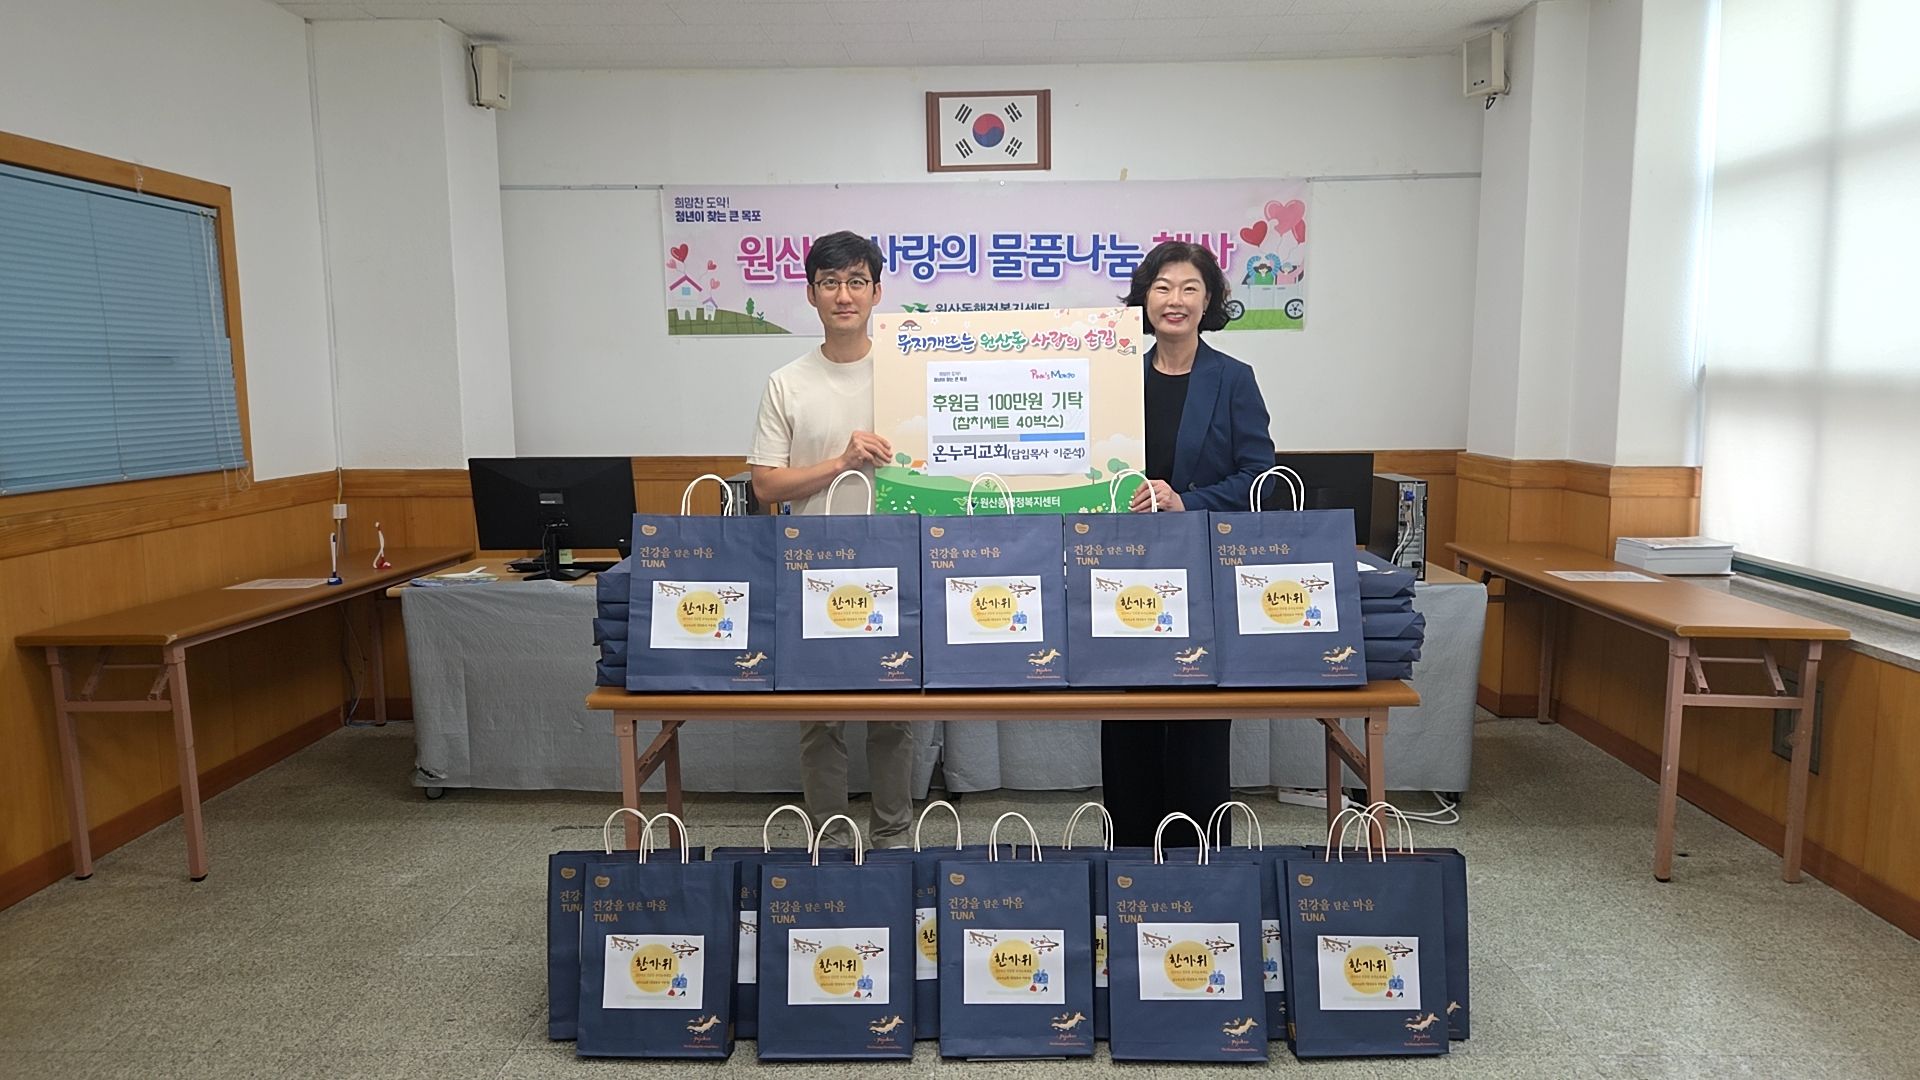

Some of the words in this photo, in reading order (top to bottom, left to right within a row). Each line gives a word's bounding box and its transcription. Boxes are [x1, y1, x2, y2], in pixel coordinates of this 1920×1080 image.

[674, 196, 703, 209] 희망찬
[675, 210, 704, 222] 청년이
[707, 210, 727, 222] 찾는
[729, 210, 740, 222] 큰
[741, 210, 762, 222] 목포
[736, 236, 812, 281] 원산
[987, 233, 1145, 279] 물품나눔
[1152, 231, 1234, 270] 사
[980, 330, 1027, 351] 원산동
[1031, 331, 1079, 350] 사랑의
[1084, 328, 1116, 347] 손길
[932, 394, 980, 413] 후원금
[987, 391, 1043, 411] 100만원
[1051, 391, 1084, 410] 기탁
[952, 415, 1010, 431] (참치세트
[1016, 414, 1064, 429] 40박스)
[1053, 447, 1085, 460] 이준석)
[639, 546, 671, 559] 건강을
[693, 546, 715, 559] 마음
[783, 549, 815, 561] 건강을
[835, 548, 857, 560] 마음
[929, 546, 960, 560] 건강을
[980, 546, 1001, 559] 마음
[1073, 544, 1104, 557] 건강을
[1125, 543, 1147, 556] 마음
[1216, 543, 1248, 556] 건강을
[1268, 543, 1291, 555] 마음
[640, 560, 666, 569] TUNA
[785, 562, 809, 571] TUNA
[930, 560, 955, 569] TUNA
[1076, 557, 1100, 566] TUNA
[1219, 557, 1243, 566] TUNA
[831, 596, 868, 610] 한가위
[975, 597, 1011, 611] 한가위
[1120, 597, 1157, 611] 한가위
[1266, 592, 1303, 606] 한가위
[682, 601, 719, 616] 한가위
[560, 903, 583, 912] TUN
[592, 899, 624, 912] 건강을
[646, 899, 668, 912] 마음
[769, 900, 802, 913] 건강을
[824, 900, 846, 913] 마음
[948, 896, 981, 910] 건강을
[1002, 896, 1024, 910] 마음
[1115, 899, 1148, 914] 건강을
[1170, 899, 1193, 914] 마음
[1297, 898, 1330, 912] 건강을
[1353, 898, 1376, 912] 마음
[593, 914, 618, 923] TUNA
[771, 915, 796, 924] TUNA
[950, 911, 975, 921] TUNA
[1118, 914, 1144, 923] TUNA
[1300, 912, 1326, 922] TUNA
[635, 956, 673, 972] 한가위
[819, 958, 858, 973] 한가위
[994, 952, 1033, 967] 한가위
[1169, 952, 1208, 968] 한가위
[1348, 958, 1387, 973] 한가위
